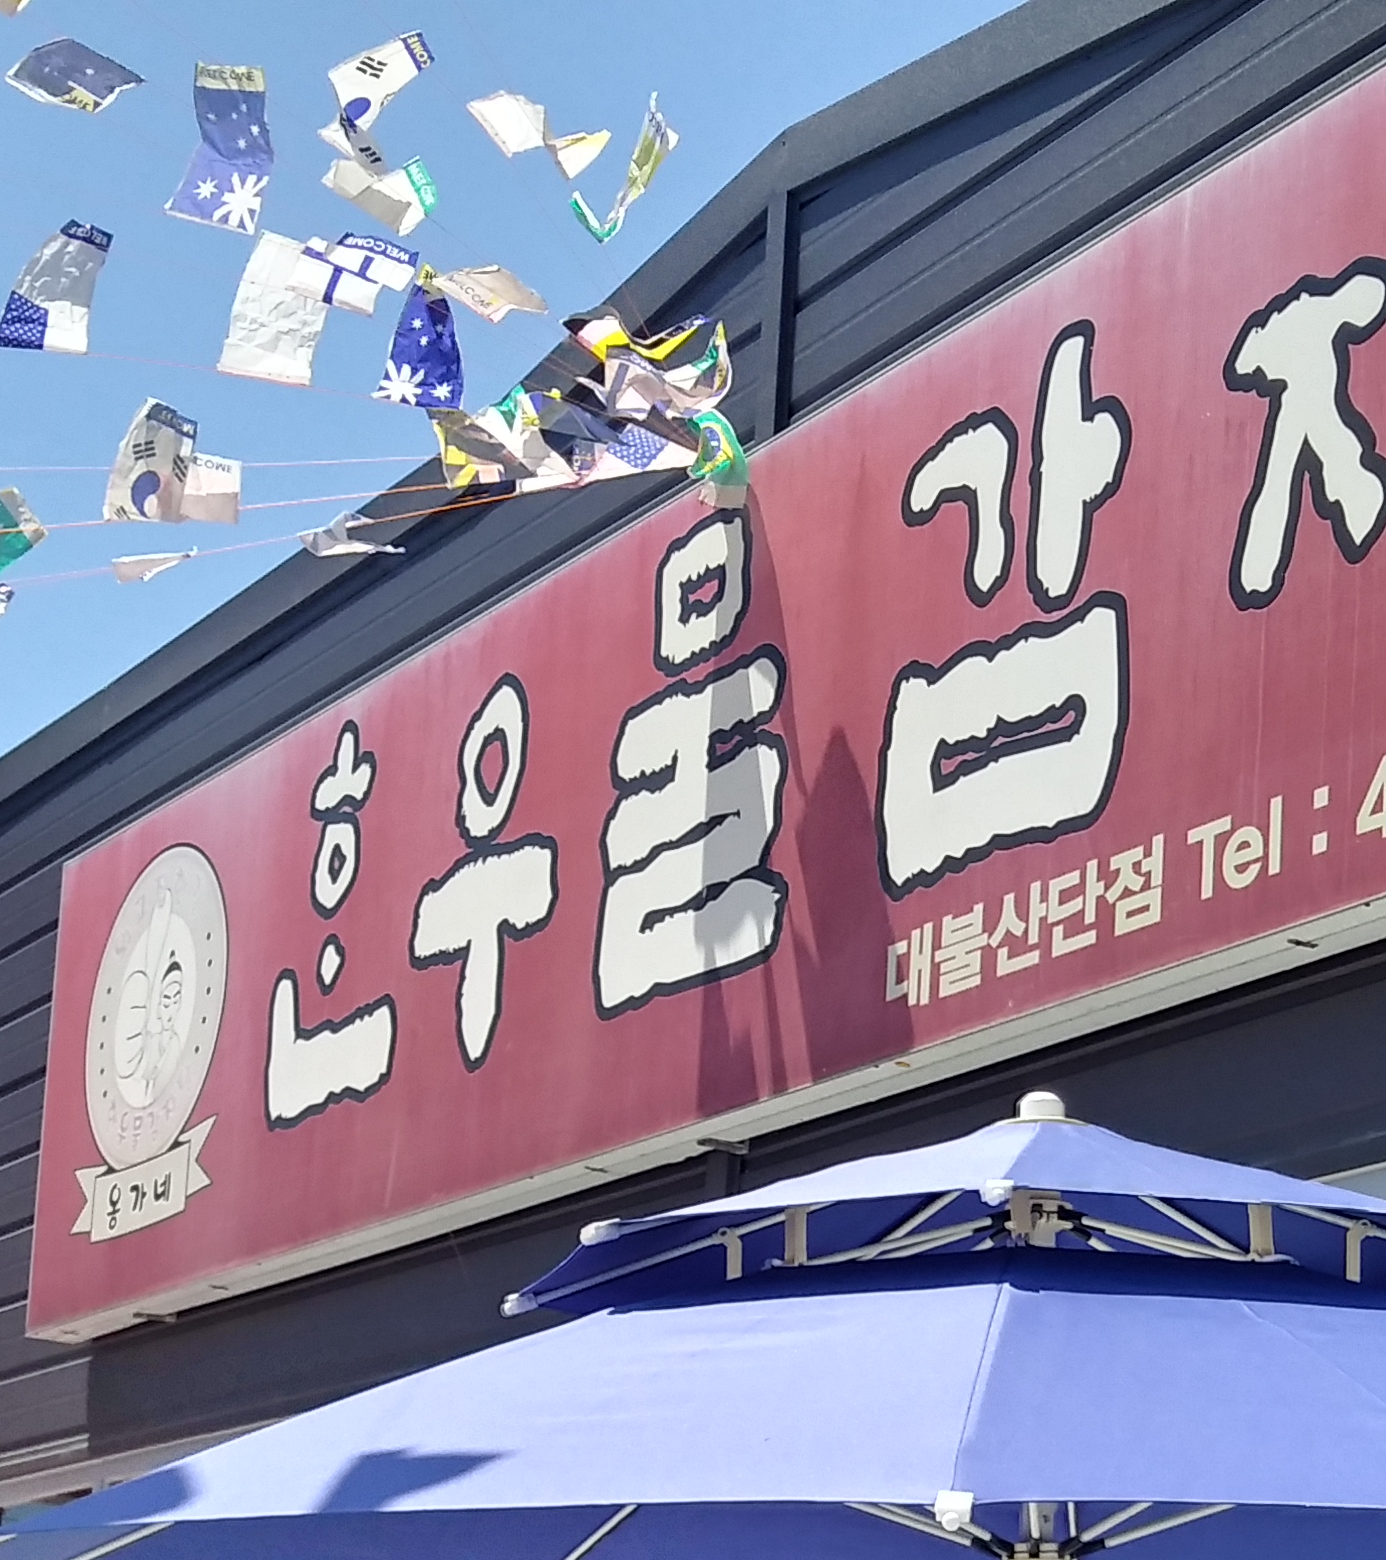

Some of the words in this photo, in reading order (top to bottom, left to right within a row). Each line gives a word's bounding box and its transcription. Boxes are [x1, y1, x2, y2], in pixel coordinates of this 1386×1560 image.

[344, 236, 410, 263] WELCOME
[884, 835, 1166, 1009] 대불산단점
[1186, 795, 1283, 902] Tel
[106, 1171, 173, 1232] 옹가네
